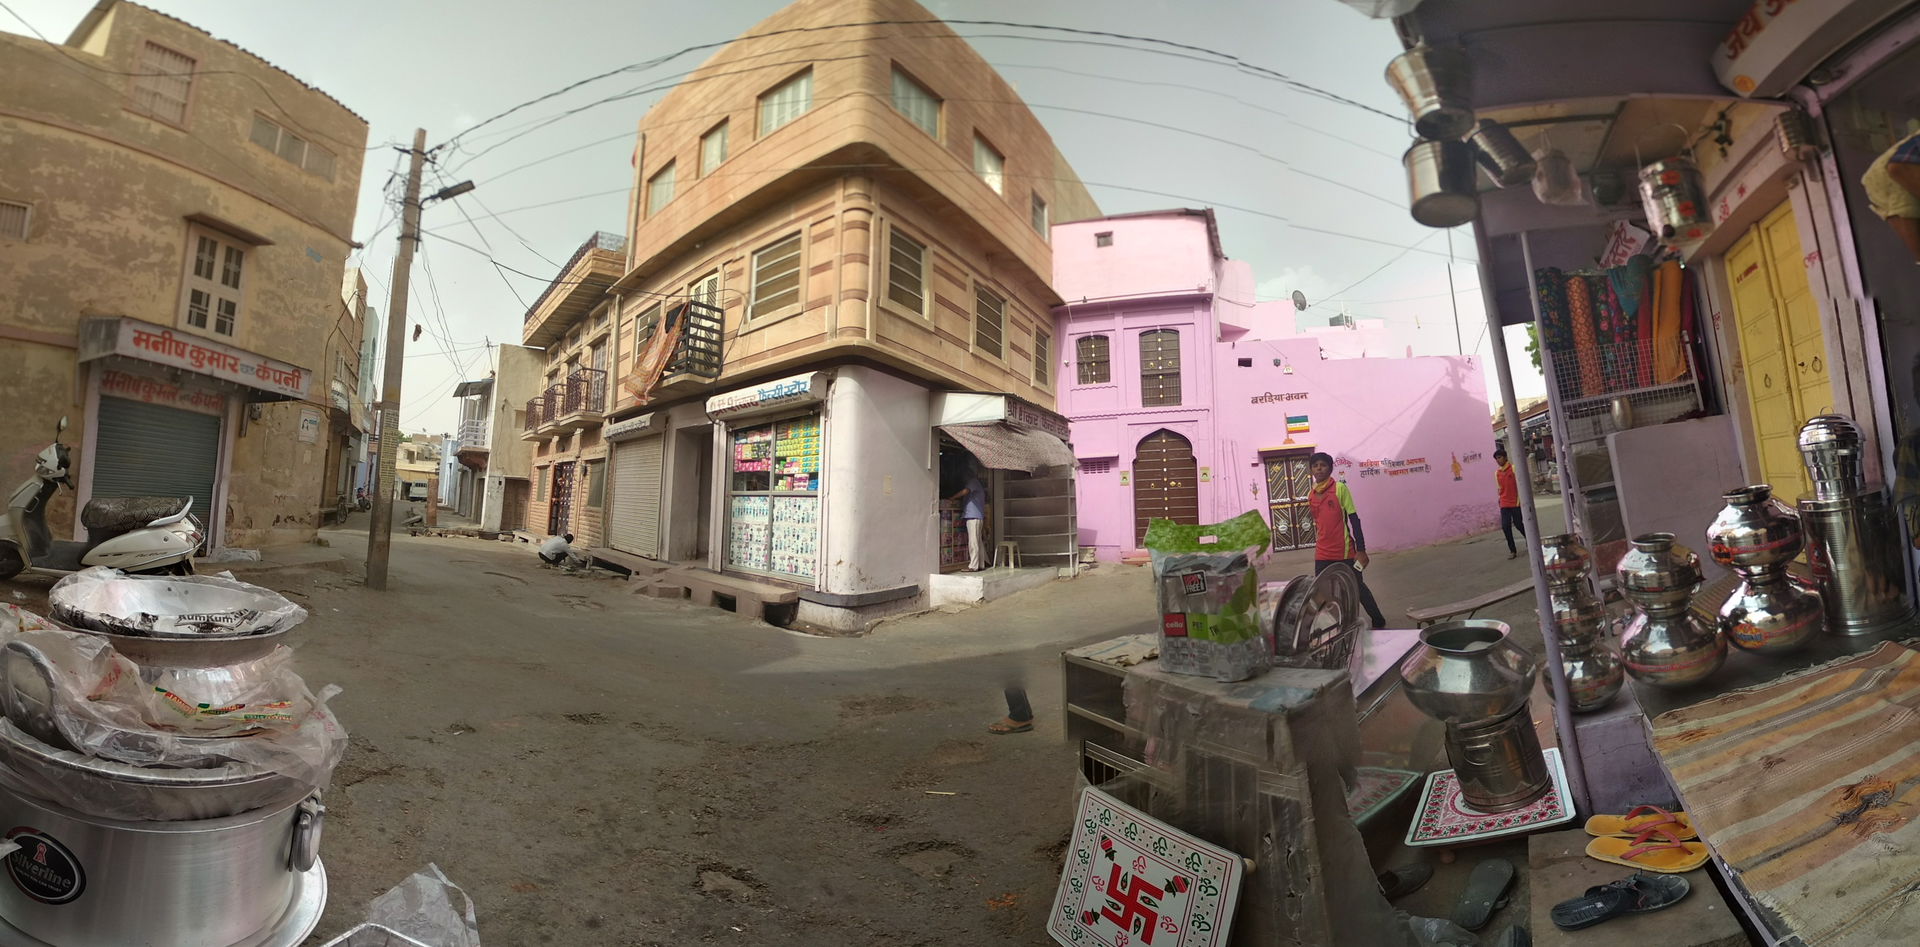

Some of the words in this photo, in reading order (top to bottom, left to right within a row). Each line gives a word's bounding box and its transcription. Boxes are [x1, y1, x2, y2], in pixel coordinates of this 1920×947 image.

[133, 329, 189, 360] मनीष
[189, 344, 240, 374] कुमार
[255, 360, 302, 390] कंपनी
[1165, 621, 1183, 629] cello
[12, 850, 72, 889] Silverline
